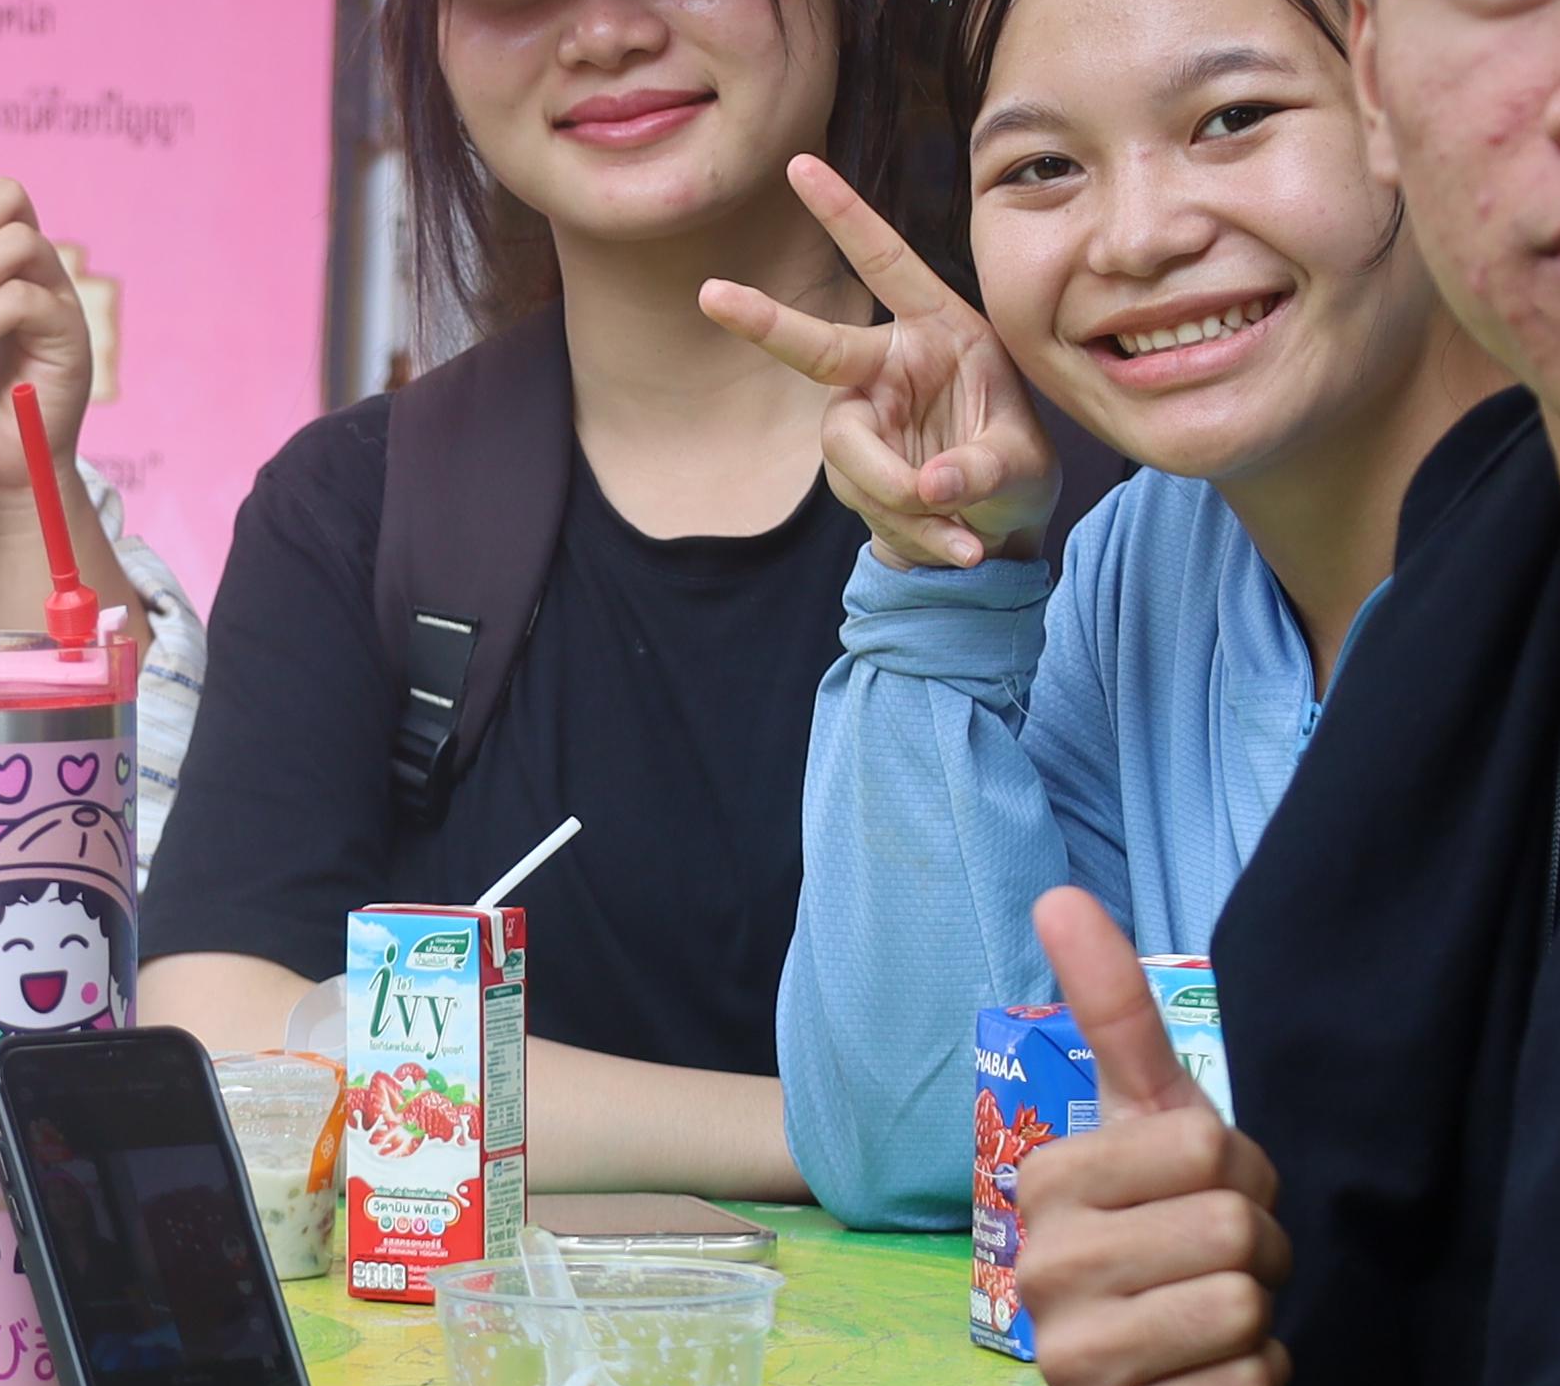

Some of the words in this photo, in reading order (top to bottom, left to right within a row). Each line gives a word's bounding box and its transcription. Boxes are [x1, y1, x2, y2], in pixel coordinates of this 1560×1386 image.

[369, 943, 456, 1060] ivy
[1068, 1049, 1095, 1060] CHA
[373, 1201, 411, 1214] วิตามิน
[413, 1203, 440, 1215] พลัส
